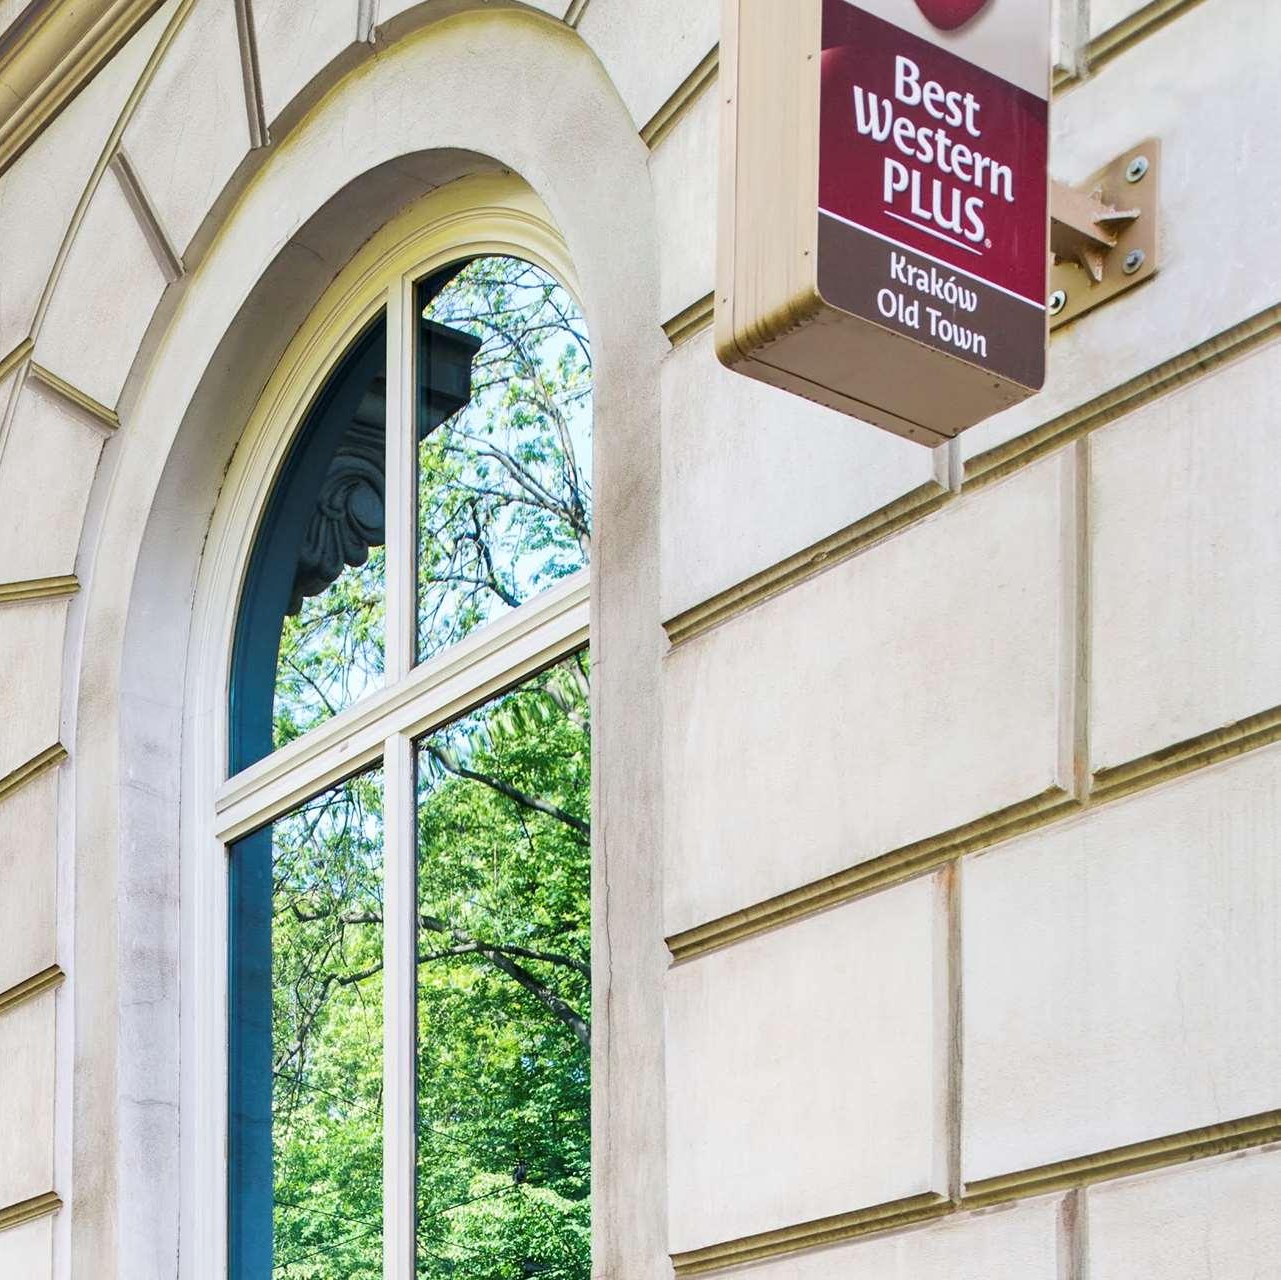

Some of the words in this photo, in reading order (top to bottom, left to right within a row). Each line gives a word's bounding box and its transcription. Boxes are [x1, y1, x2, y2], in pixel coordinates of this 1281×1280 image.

[894, 54, 981, 138] Best
[853, 85, 1016, 203] Western
[883, 157, 986, 246] PLUS
[877, 287, 921, 330] Old
[926, 309, 987, 358] Town
[889, 251, 978, 313] Kraków
